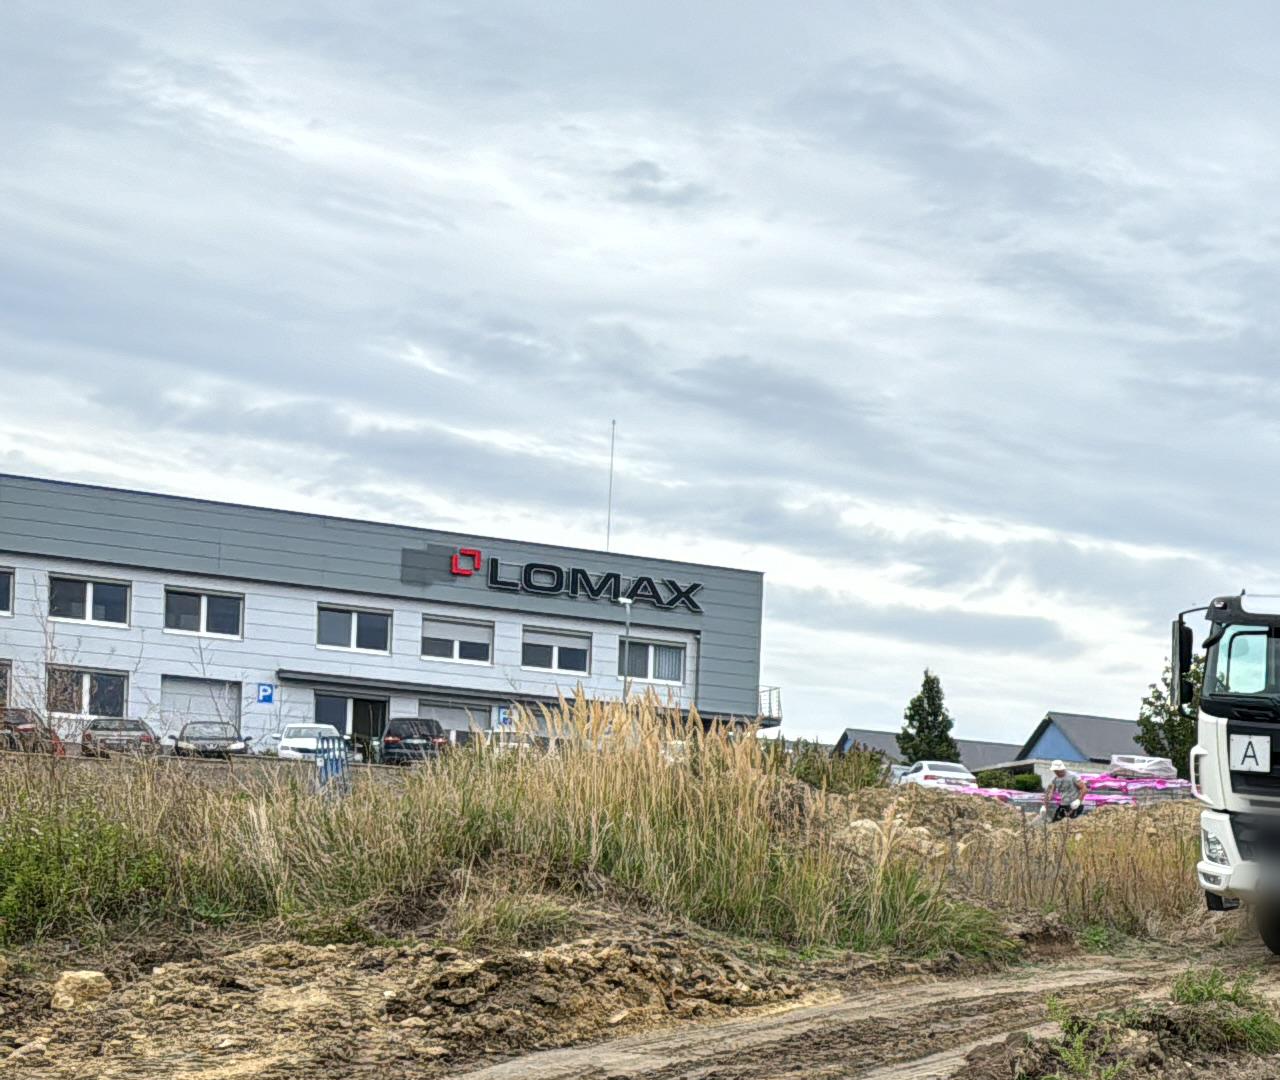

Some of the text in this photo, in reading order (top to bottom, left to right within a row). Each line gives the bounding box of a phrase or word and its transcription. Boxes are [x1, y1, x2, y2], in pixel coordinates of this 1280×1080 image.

[488, 556, 703, 613] LOMAX
[258, 685, 271, 698] P
[1241, 741, 1258, 766] A
